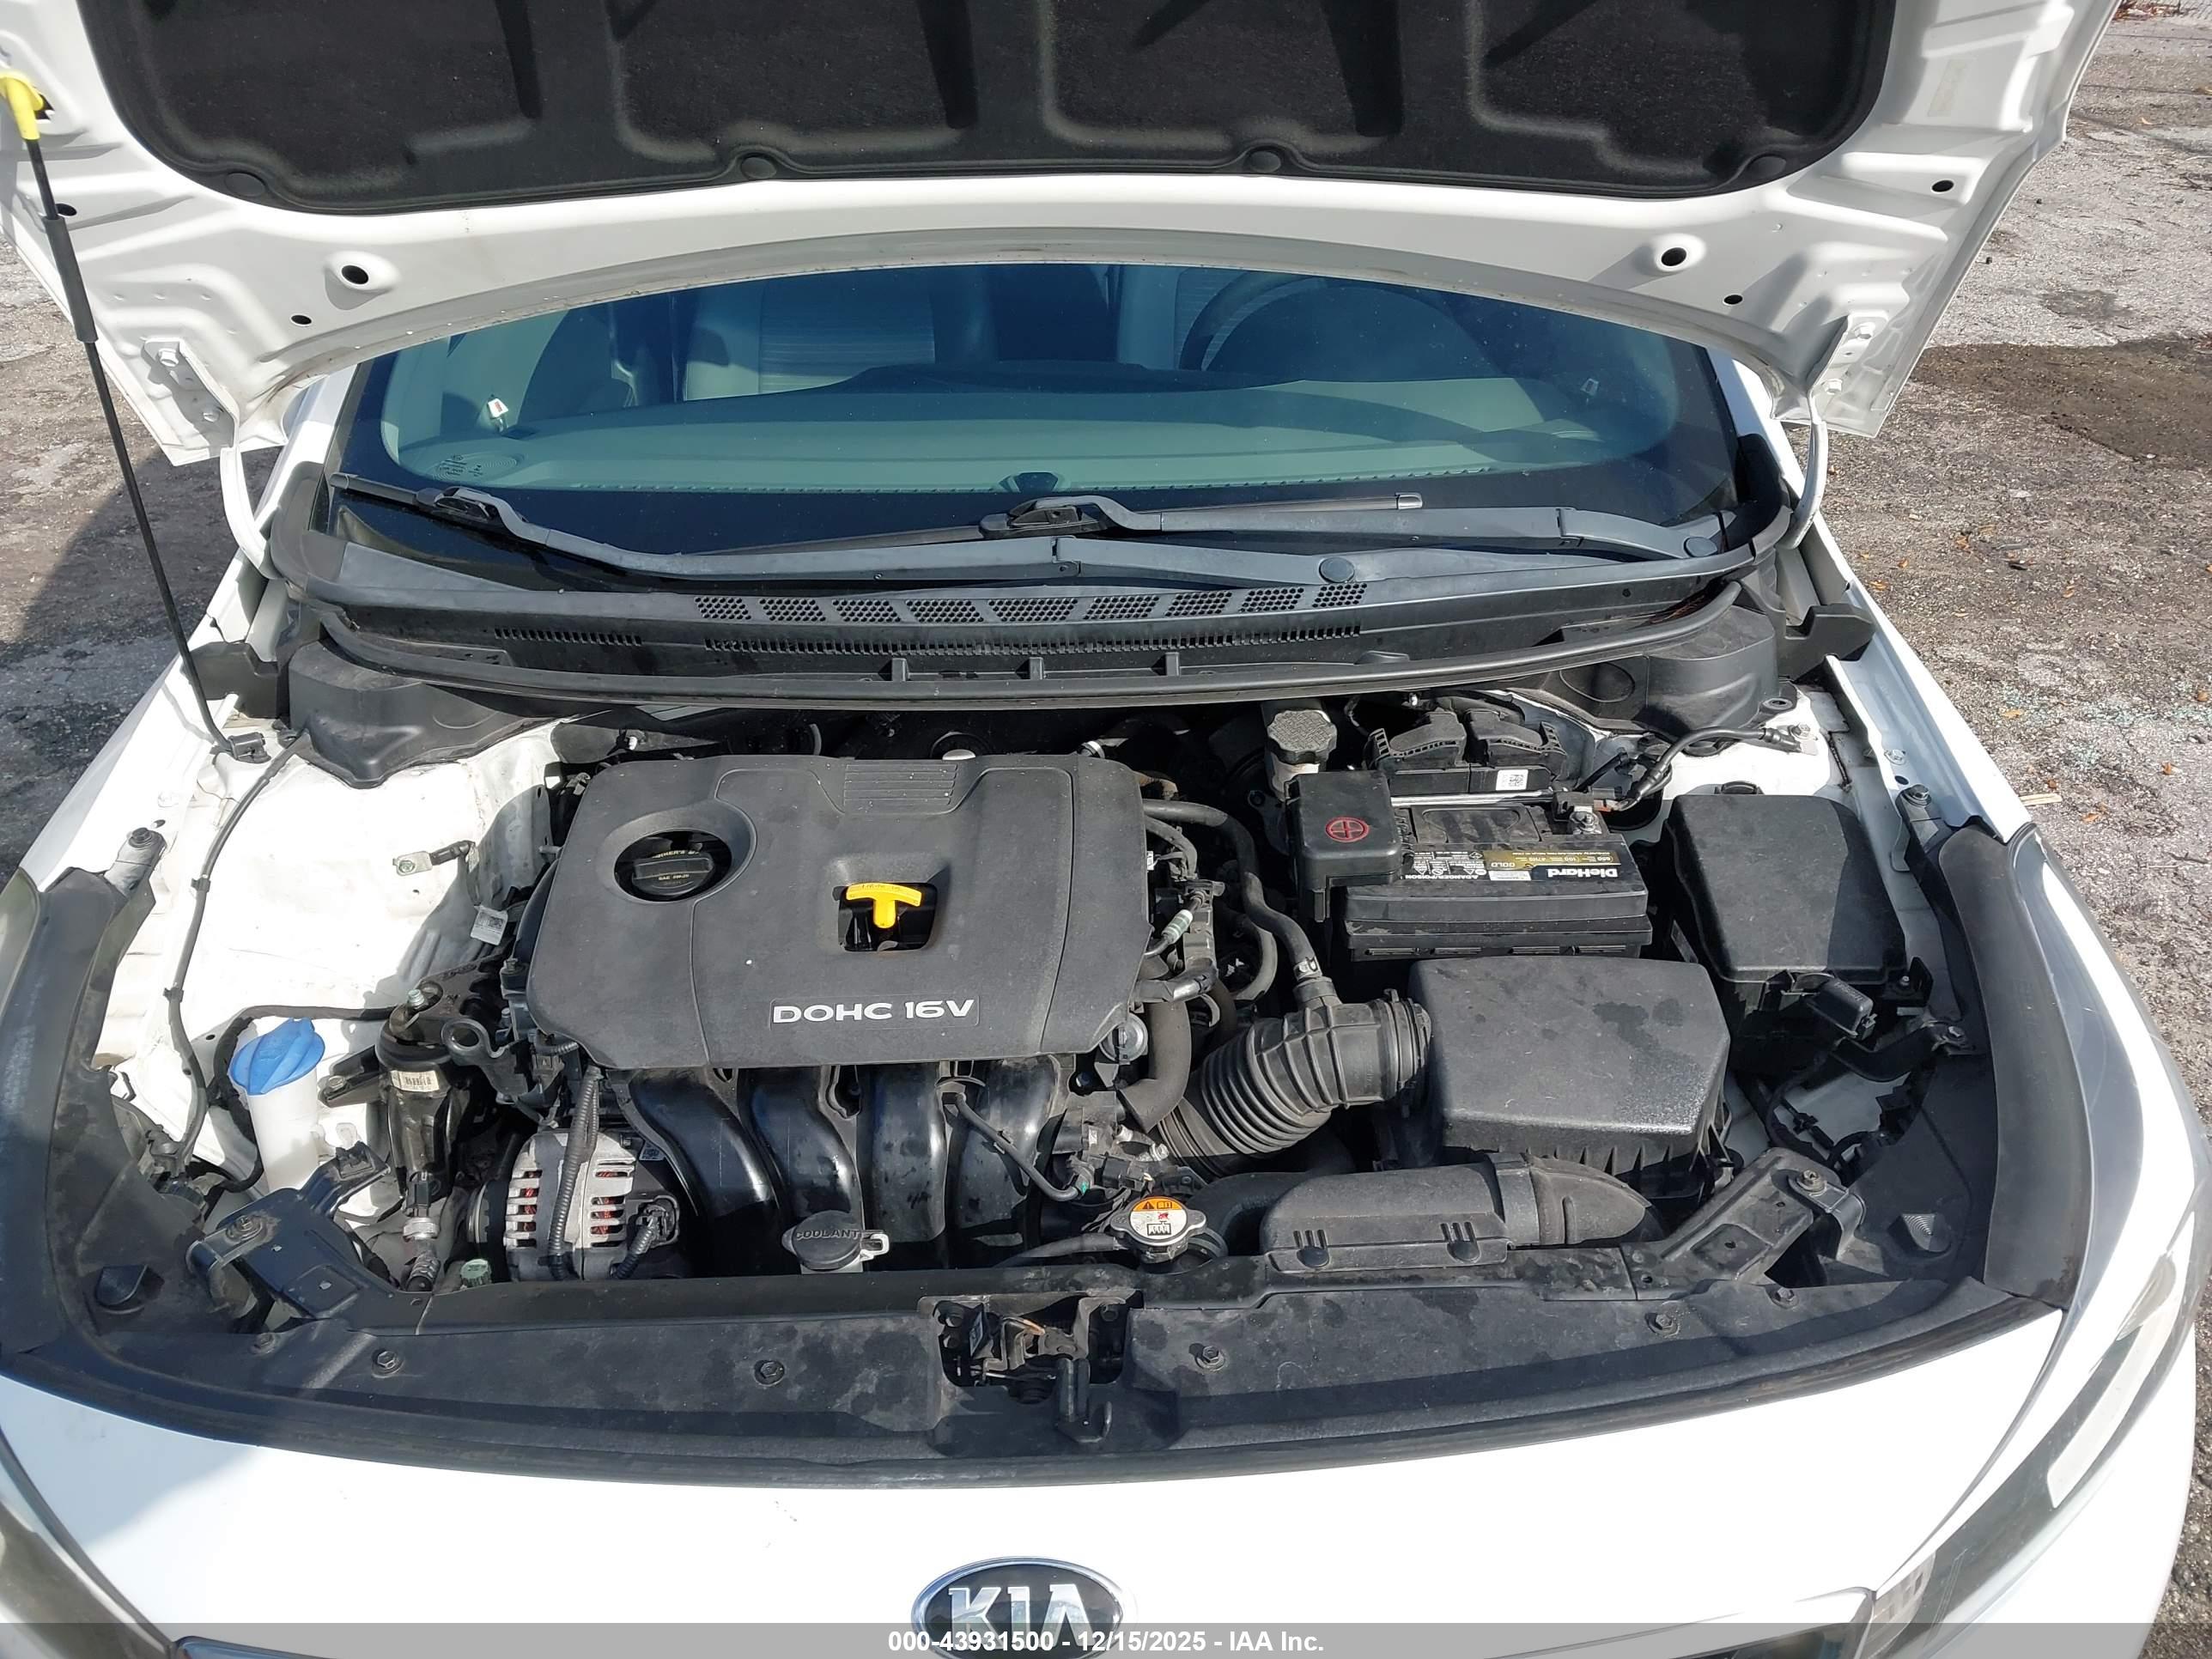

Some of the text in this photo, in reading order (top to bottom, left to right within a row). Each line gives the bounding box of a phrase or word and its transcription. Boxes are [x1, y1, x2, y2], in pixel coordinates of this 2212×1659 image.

[1547, 868, 1619, 878] DieHard
[773, 999, 975, 1024] DOHC 16V
[796, 1229, 860, 1241] COOLANT
[948, 1583, 1096, 1650] KIA
